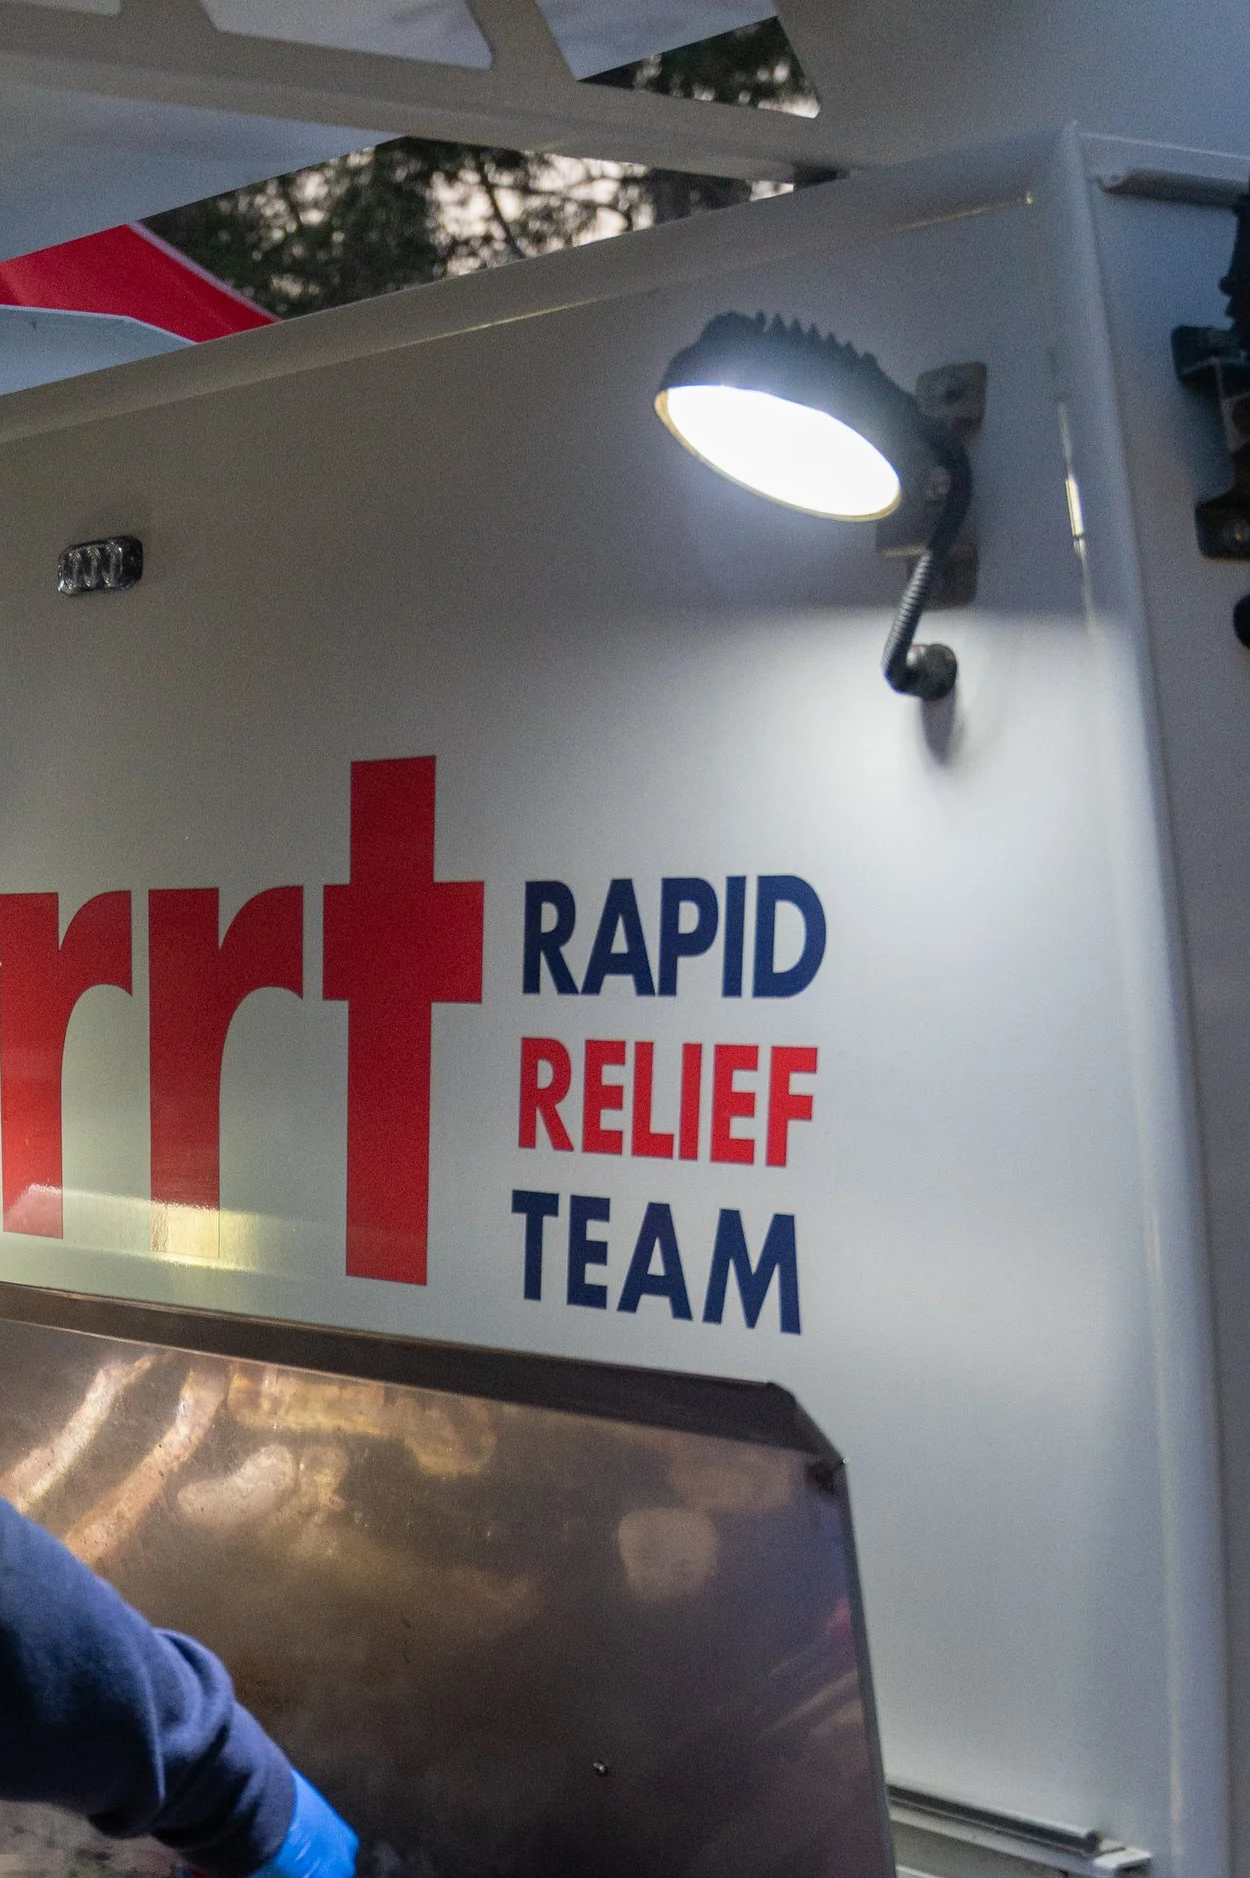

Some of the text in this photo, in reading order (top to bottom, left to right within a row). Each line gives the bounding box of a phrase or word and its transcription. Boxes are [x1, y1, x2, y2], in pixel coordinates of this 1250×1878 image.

[521, 874, 828, 999] RAPID
[517, 1036, 819, 1168] RELIEF
[511, 1188, 802, 1336] TEAM
